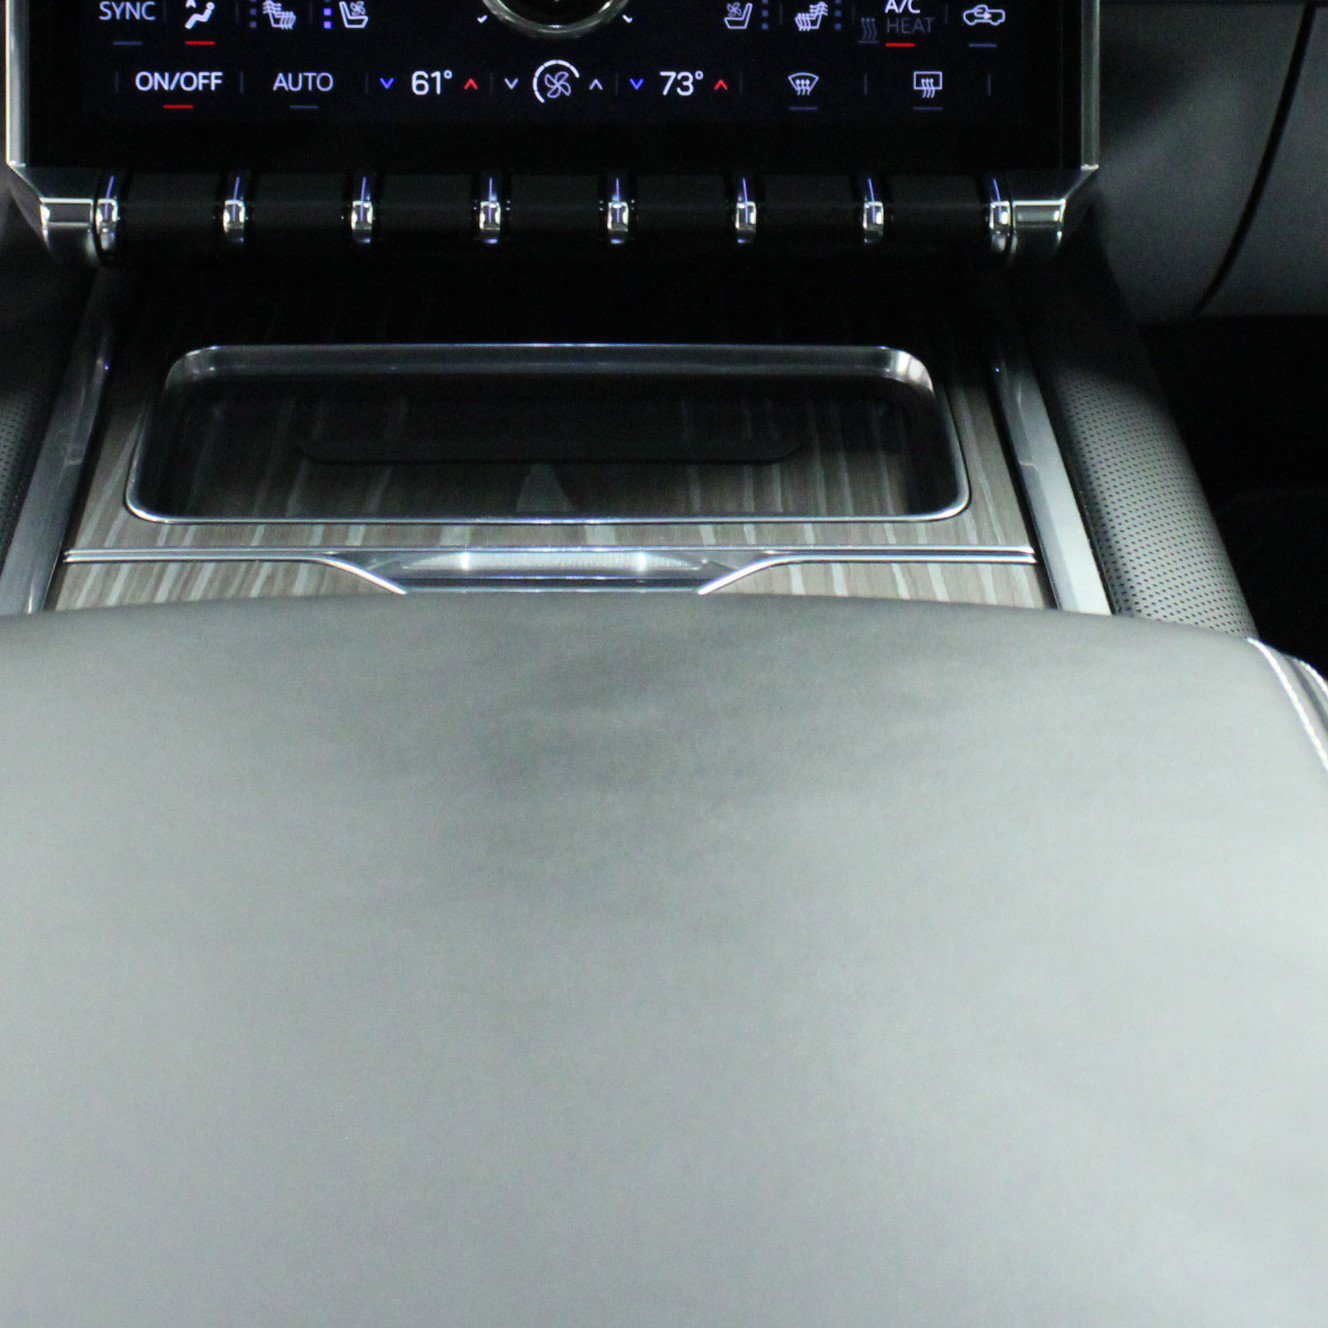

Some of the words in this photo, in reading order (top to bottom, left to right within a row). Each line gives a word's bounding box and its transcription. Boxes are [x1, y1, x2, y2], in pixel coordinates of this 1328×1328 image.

[98, 0, 156, 21] SYNC
[886, 17, 935, 34] HEAT
[135, 70, 224, 92] ON/OFF
[272, 71, 335, 92] AUTO
[411, 70, 453, 96] 61°
[659, 70, 704, 97] 73°
